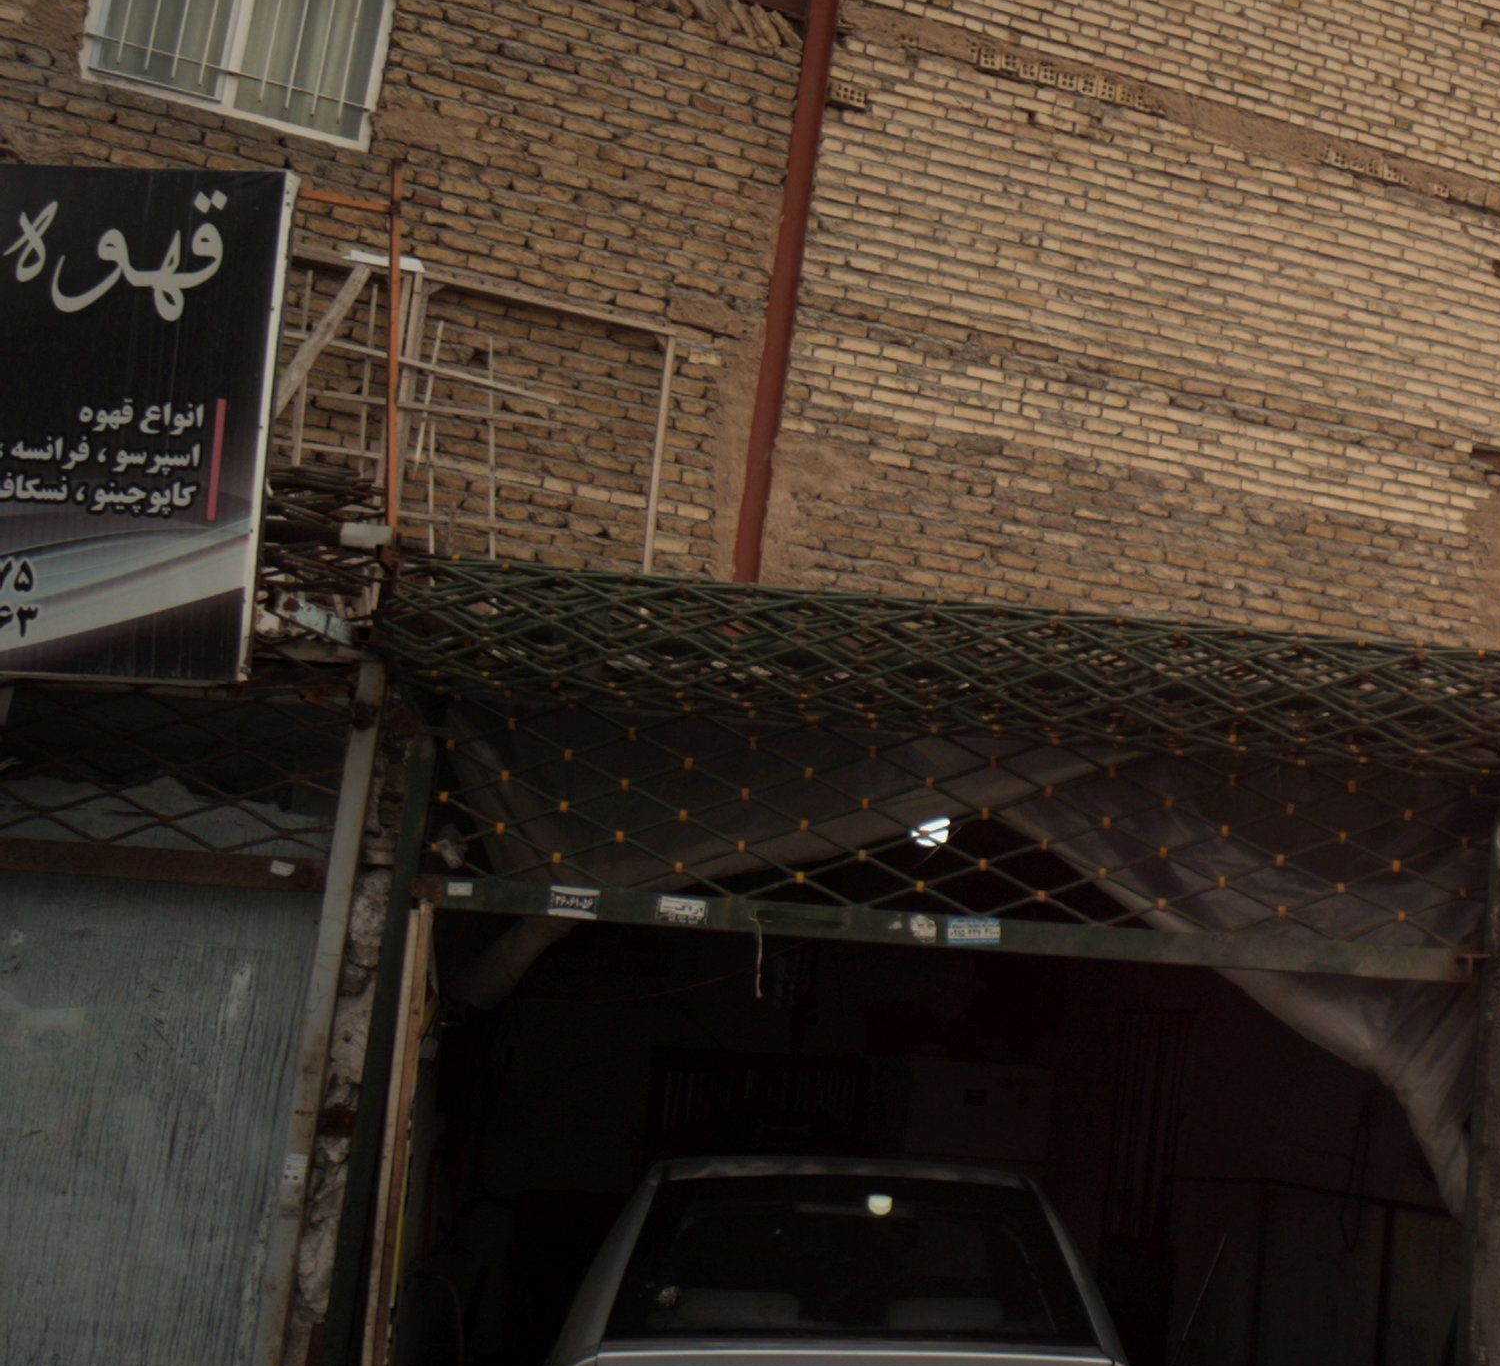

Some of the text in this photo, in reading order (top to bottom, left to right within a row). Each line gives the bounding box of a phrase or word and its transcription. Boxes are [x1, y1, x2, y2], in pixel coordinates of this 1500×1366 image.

[3, 189, 228, 323] قهوه
[78, 397, 205, 436] انواع قهوه
[9, 435, 91, 470] فرانسه
[111, 443, 201, 475] اسپرسو
[0, 471, 69, 502] نسکاف
[90, 480, 198, 516] کاپوچینو
